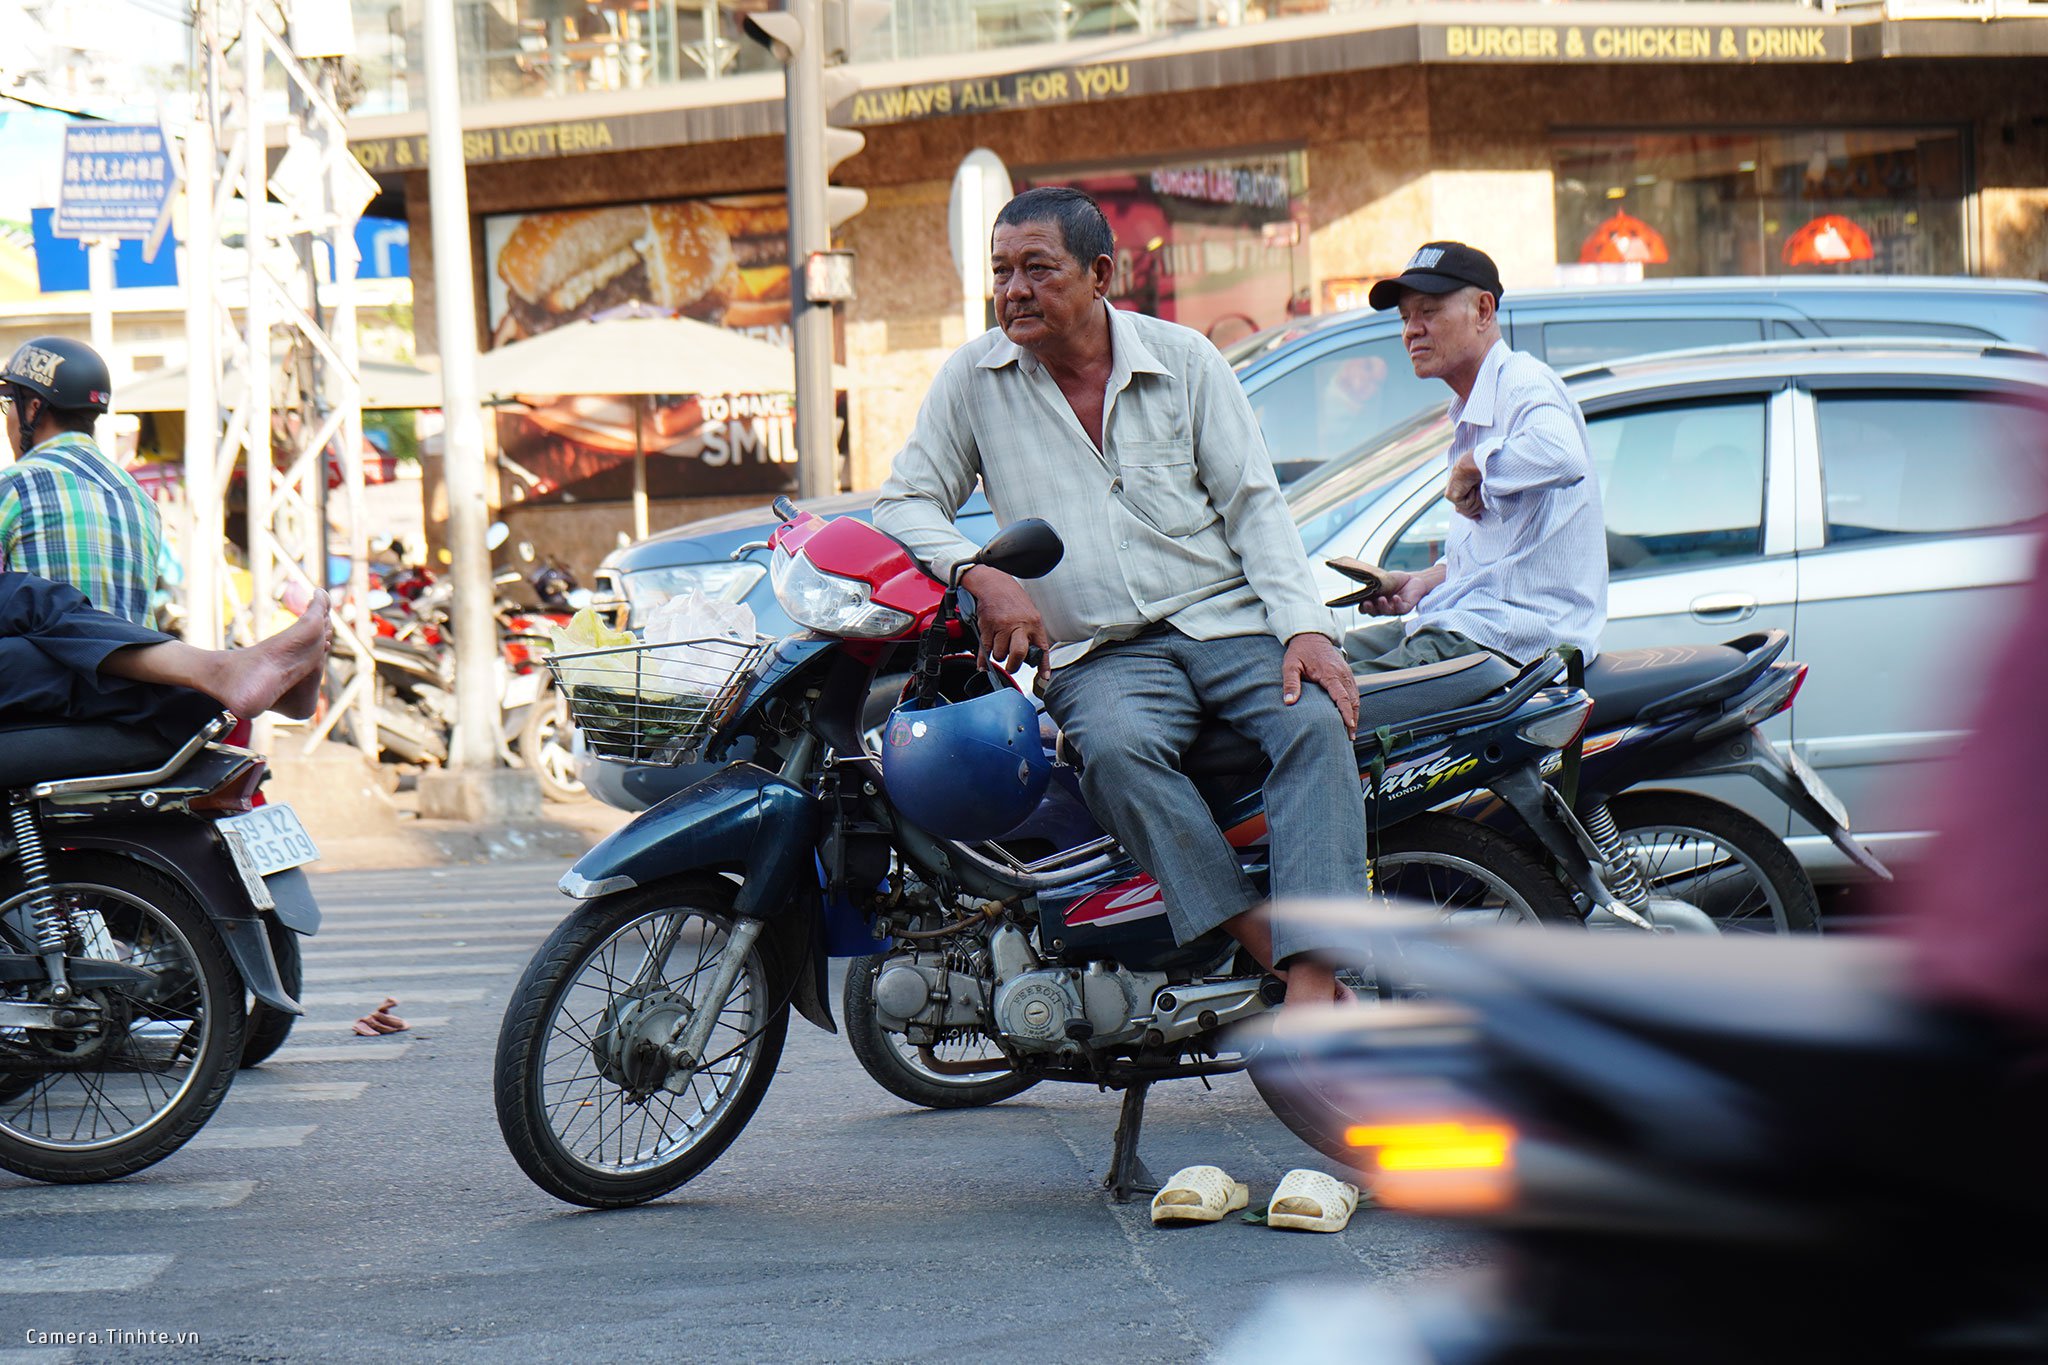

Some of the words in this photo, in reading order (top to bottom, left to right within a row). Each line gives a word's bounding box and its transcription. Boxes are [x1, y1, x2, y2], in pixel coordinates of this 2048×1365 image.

[1446, 26, 1558, 56] BURGER
[1565, 27, 1585, 56] &
[1593, 27, 1711, 56] CHICKEN
[1718, 27, 1739, 56] &
[1746, 27, 1826, 57] DRINK
[853, 84, 951, 121] ALWAYS
[960, 82, 1009, 109] ALL
[1015, 72, 1068, 104] FOR
[1075, 65, 1129, 102] YOU
[395, 139, 415, 166] &
[499, 122, 613, 156] LOTTERIA
[699, 396, 730, 421] TO
[730, 394, 790, 418] MAKE
[1424, 757, 1480, 793] 110
[1387, 783, 1425, 801] HONDA
